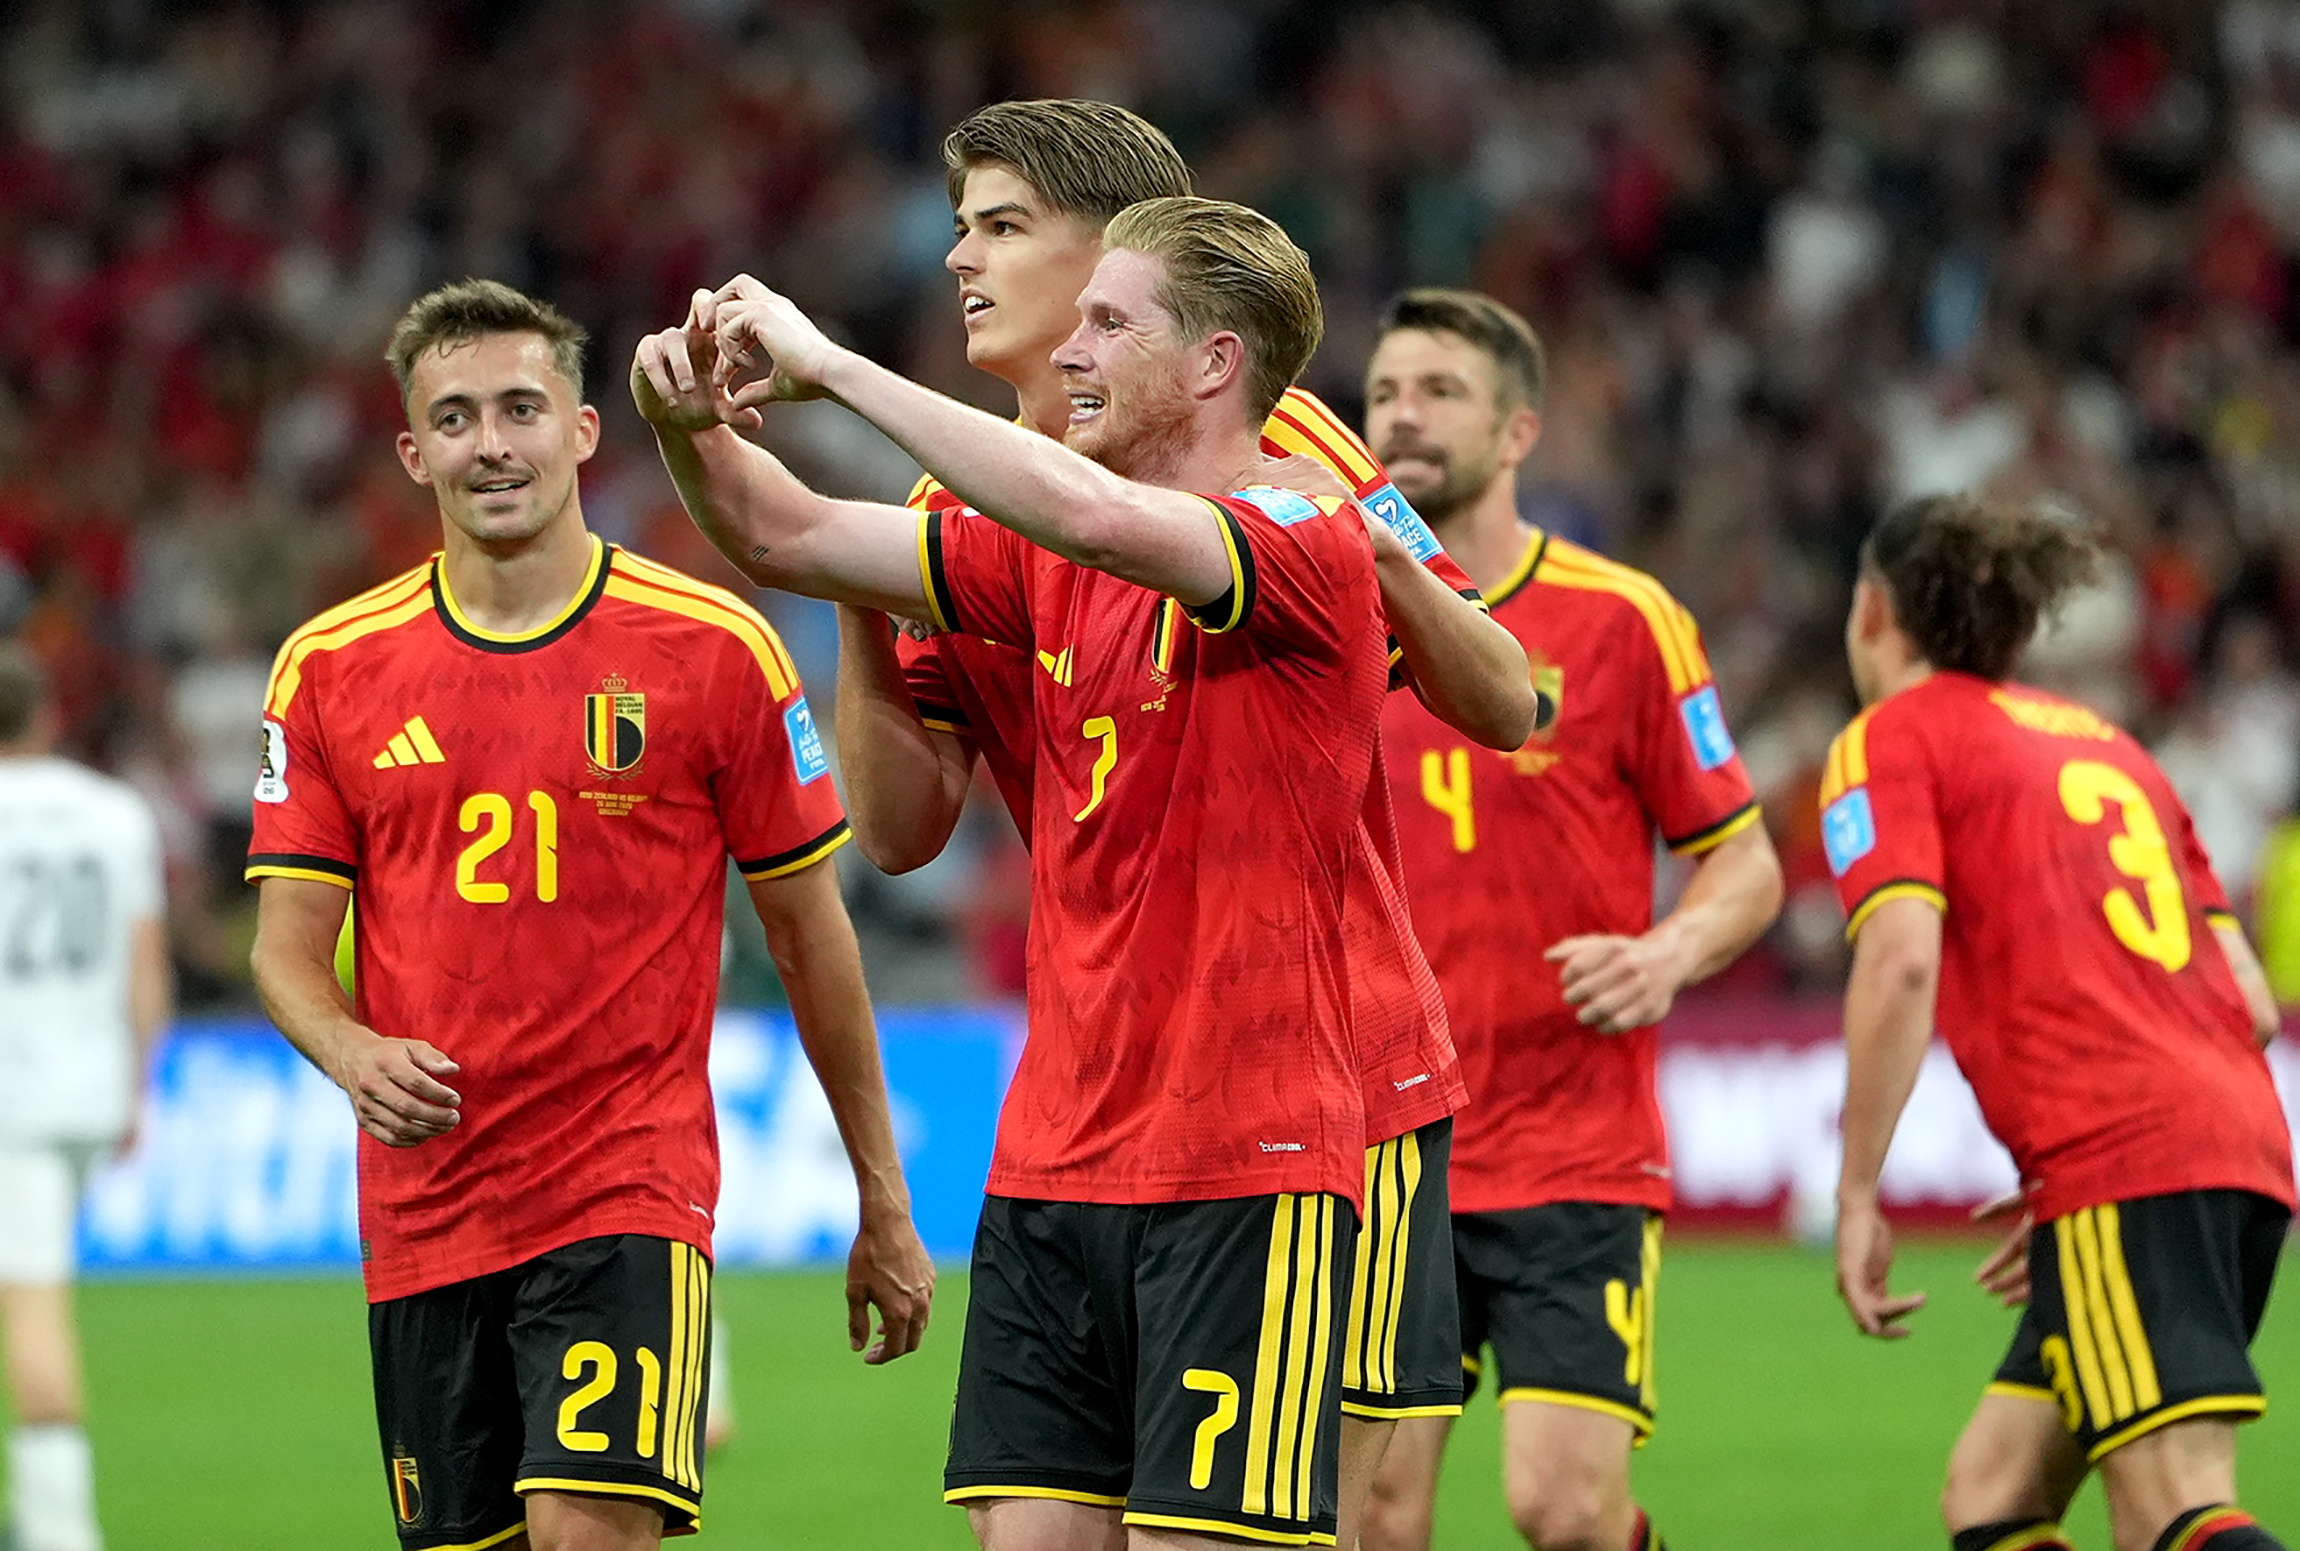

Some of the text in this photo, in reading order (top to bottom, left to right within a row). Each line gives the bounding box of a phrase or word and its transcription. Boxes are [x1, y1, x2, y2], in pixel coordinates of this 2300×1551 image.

[1400, 527, 1424, 549] ACE
[1074, 716, 1117, 822] 7
[1422, 748, 1475, 852] 4
[456, 790, 558, 903] 21
[2058, 757, 2191, 973] 3
[3, 850, 107, 978] 20
[1605, 1277, 1642, 1387] 4
[557, 1341, 660, 1458] 21
[1182, 1368, 1240, 1490] 7
